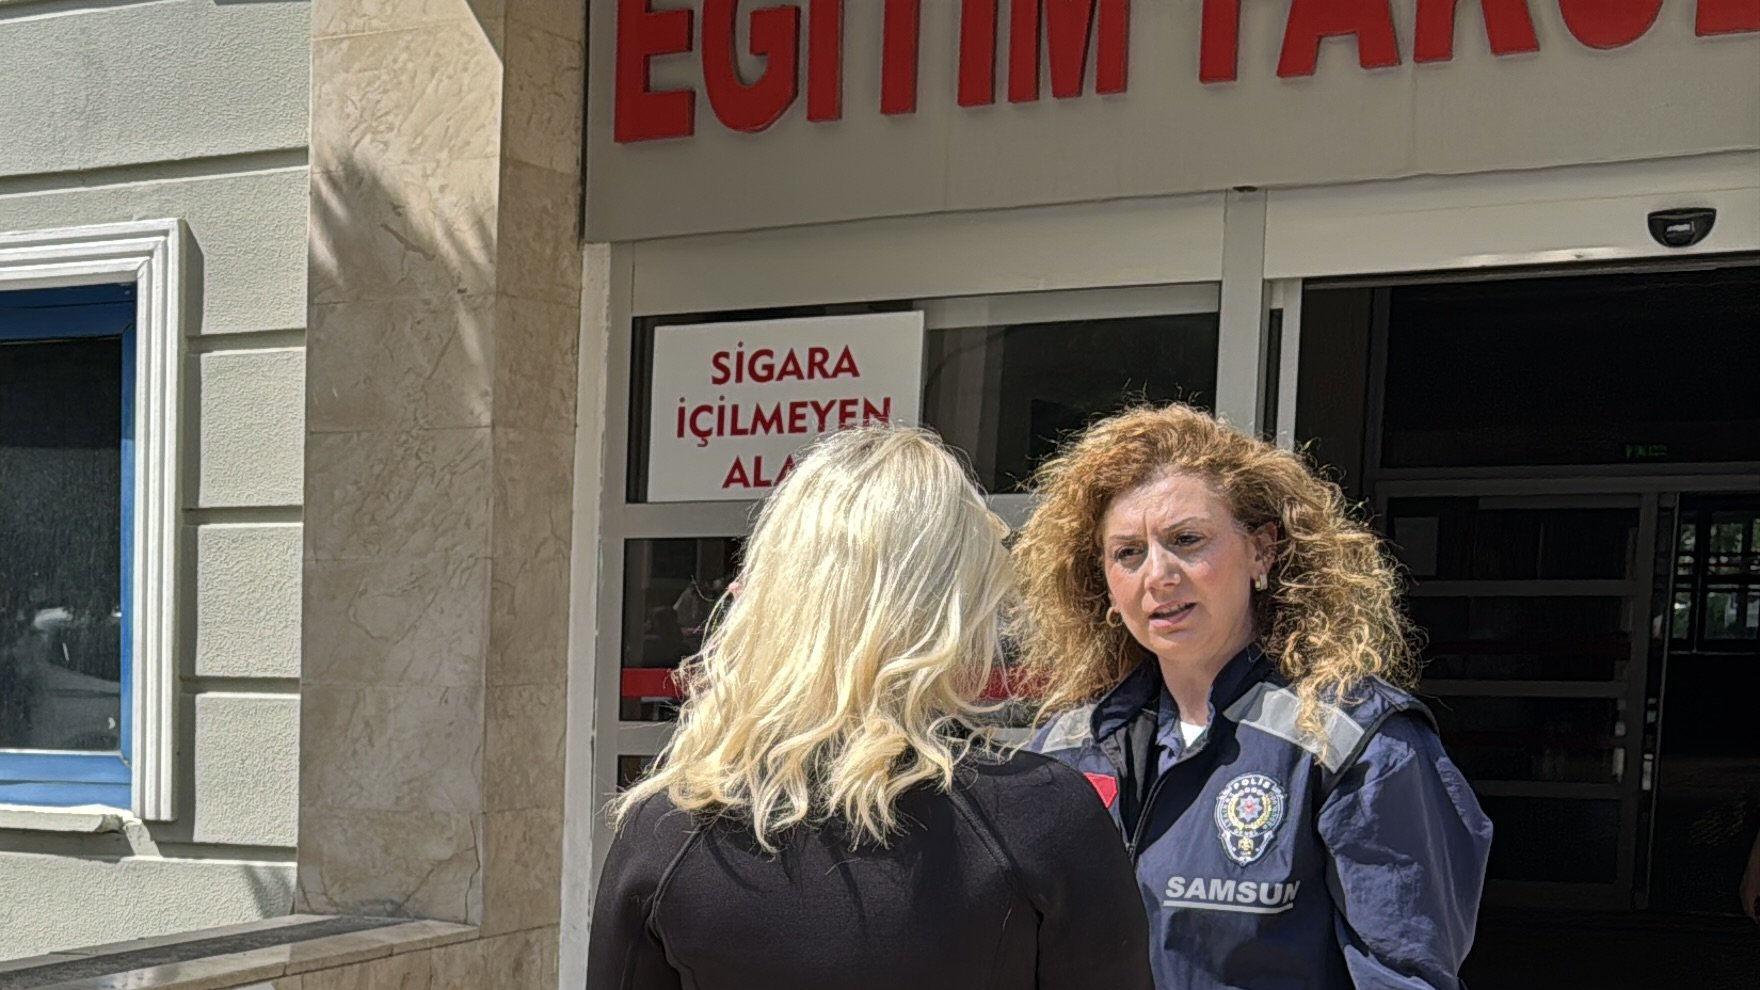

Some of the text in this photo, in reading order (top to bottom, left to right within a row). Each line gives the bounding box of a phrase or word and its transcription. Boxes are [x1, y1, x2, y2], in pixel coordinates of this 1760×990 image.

[711, 341, 860, 385] SİGARA
[676, 394, 891, 447] İÇİLMEYEN
[722, 454, 796, 488] ALA
[1165, 876, 1300, 905] SAMSUN
